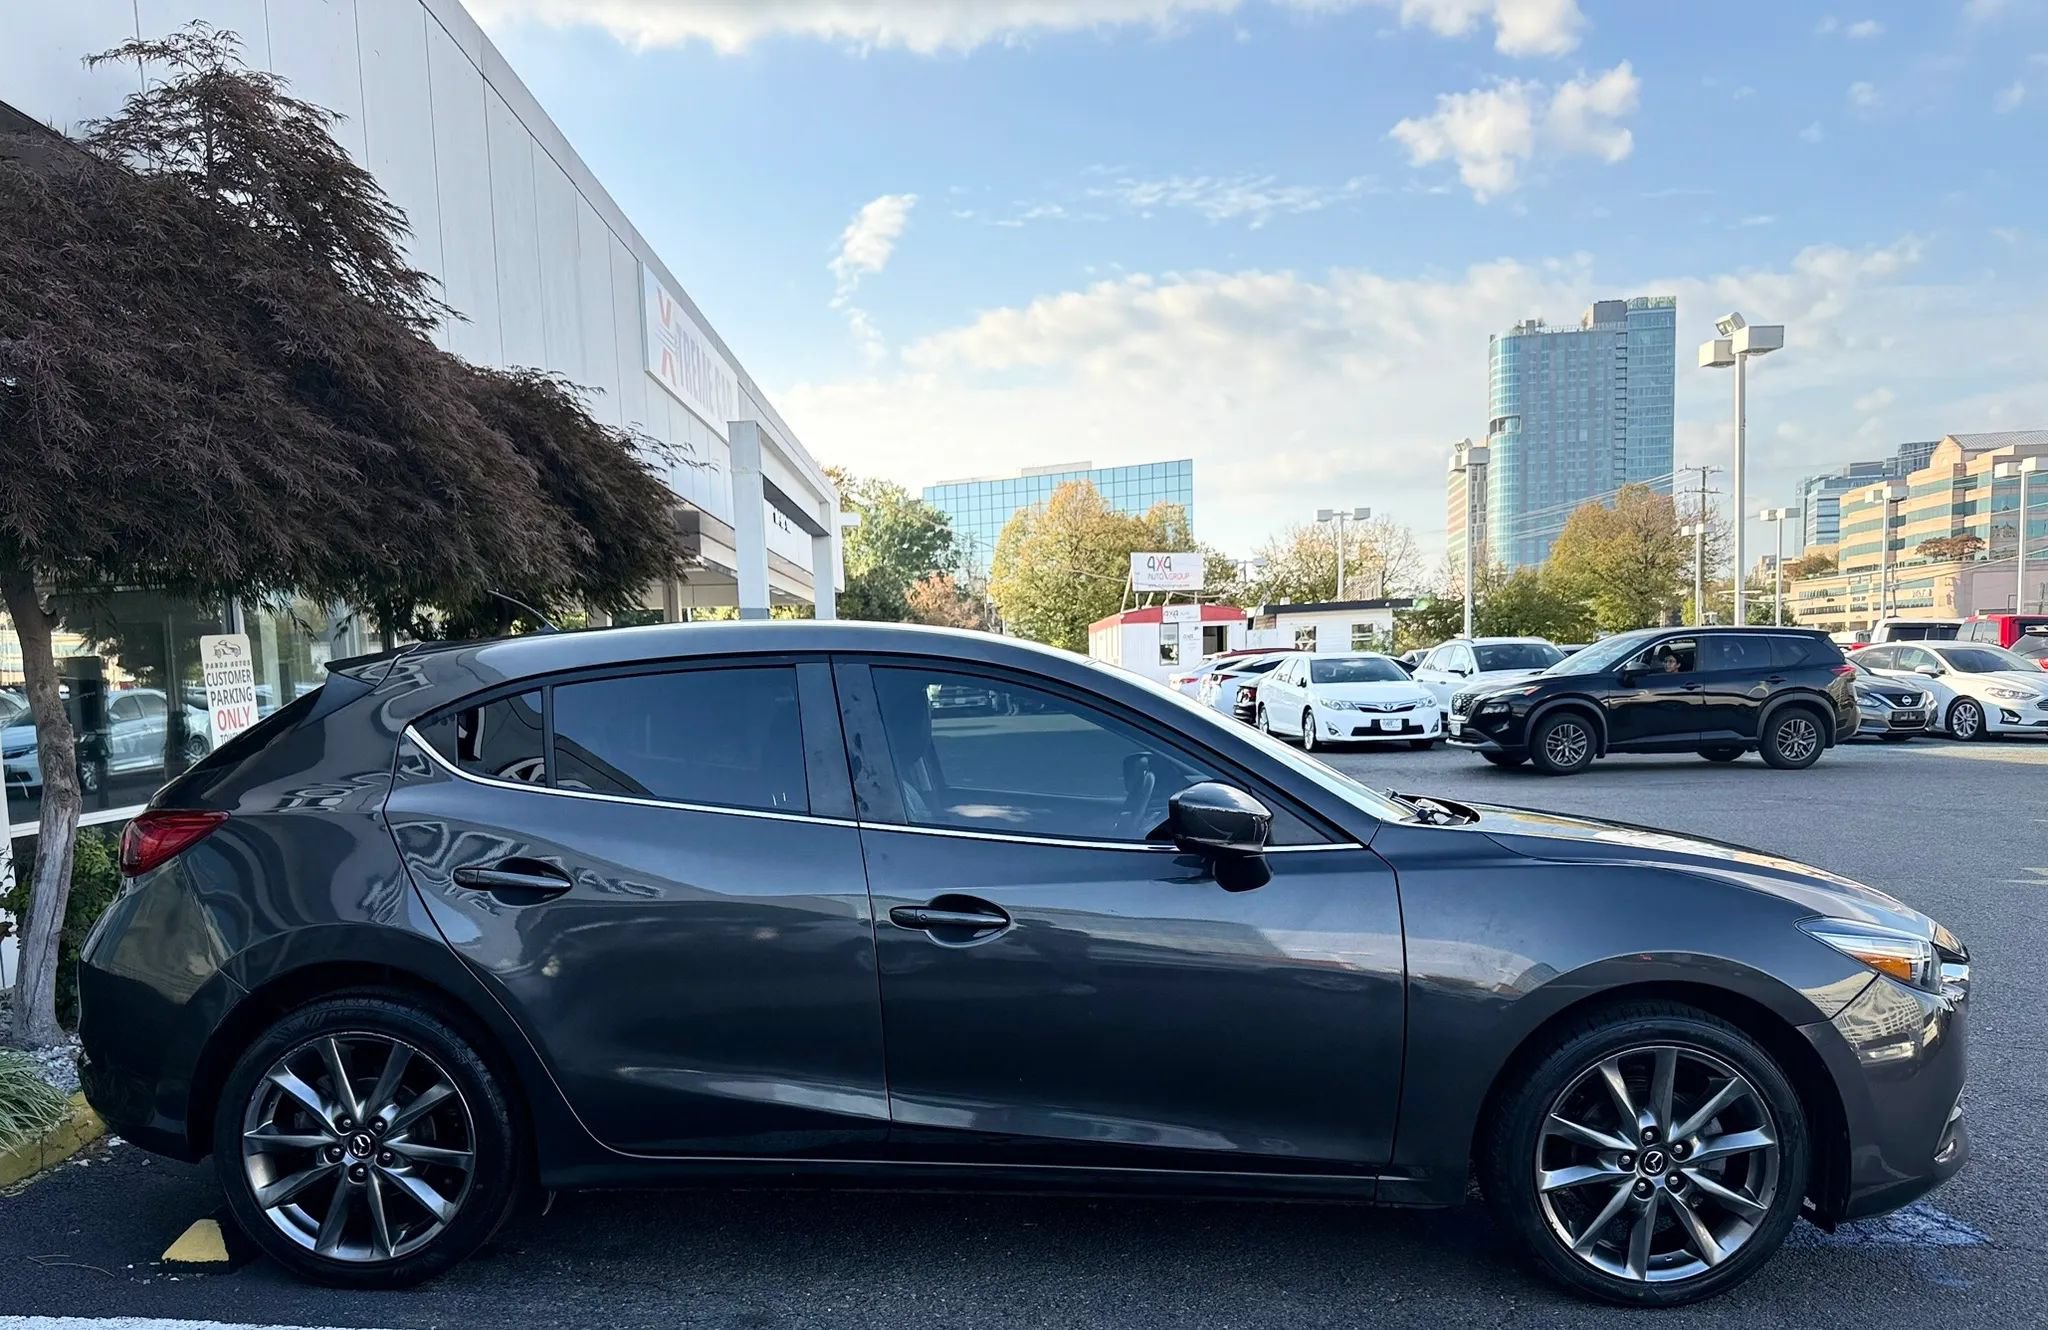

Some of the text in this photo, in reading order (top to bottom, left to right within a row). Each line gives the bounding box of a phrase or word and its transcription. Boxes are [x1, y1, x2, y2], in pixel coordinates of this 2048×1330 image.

[1168, 572, 1190, 581] GROUP
[206, 669, 252, 687] CUSTOMER
[210, 686, 253, 707] PARKING
[217, 706, 251, 731] ONLY
